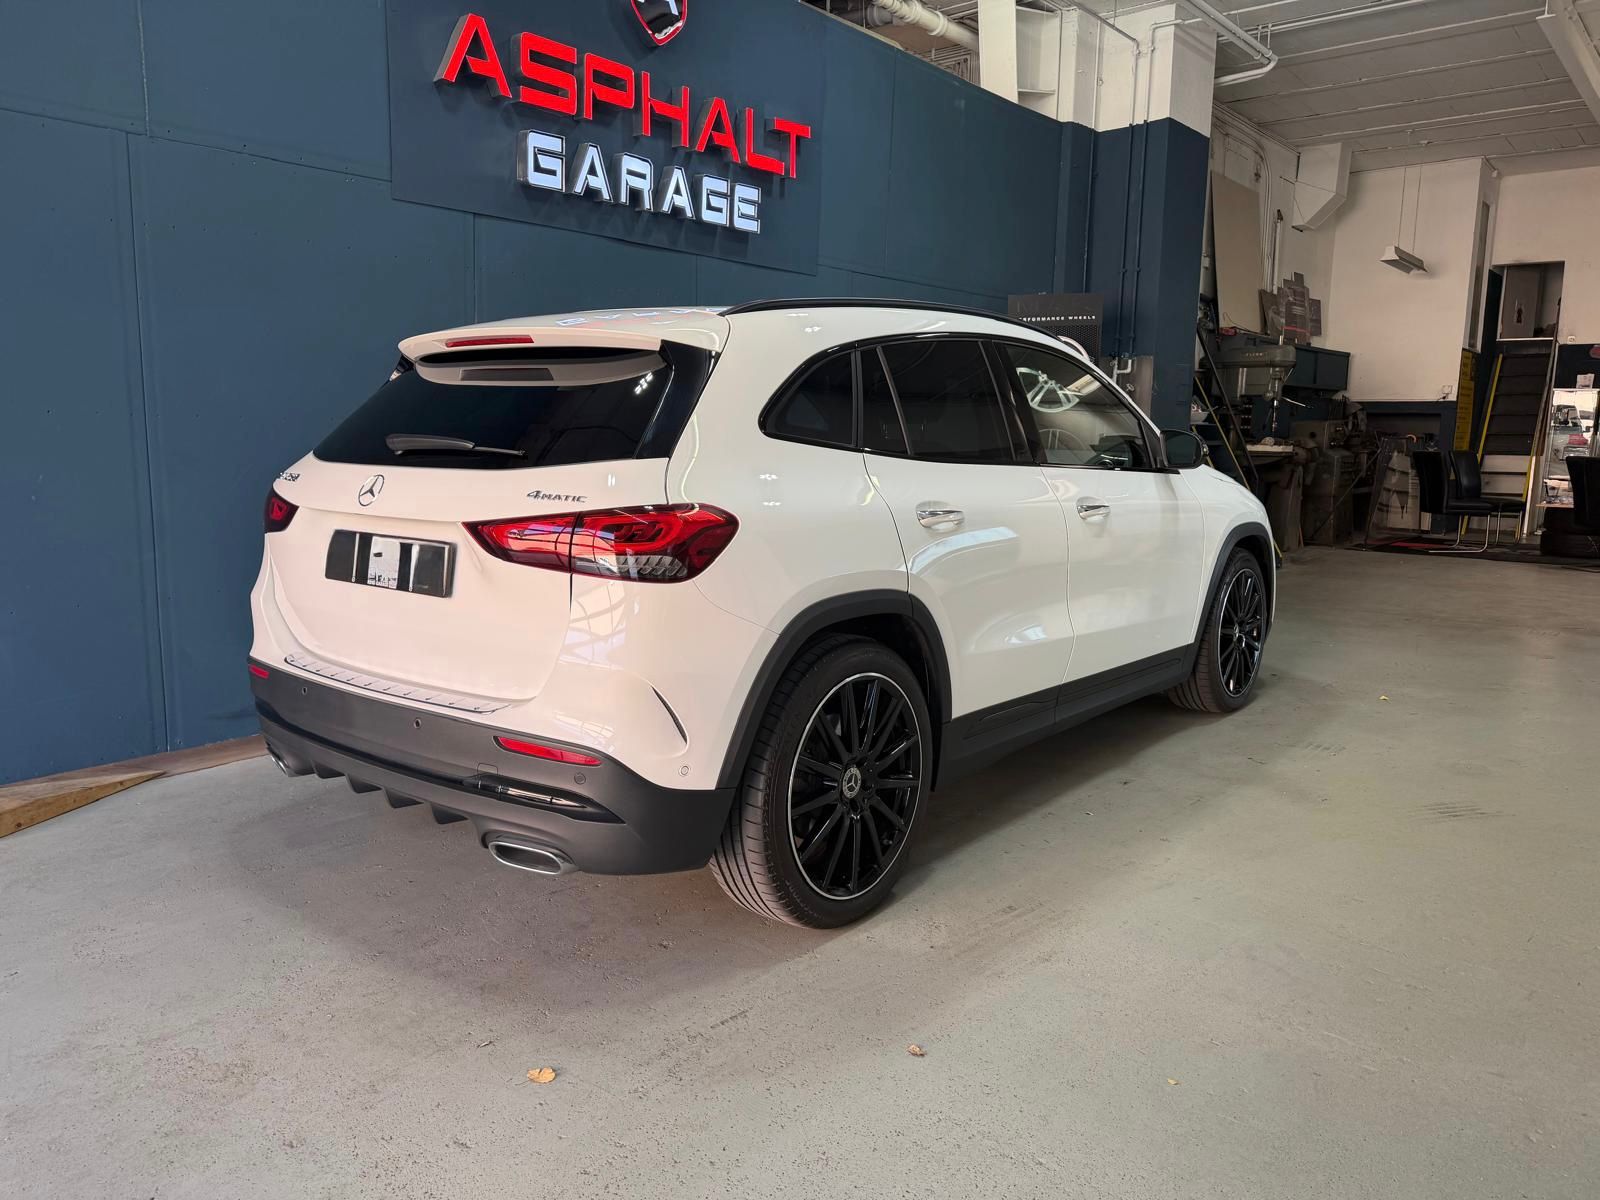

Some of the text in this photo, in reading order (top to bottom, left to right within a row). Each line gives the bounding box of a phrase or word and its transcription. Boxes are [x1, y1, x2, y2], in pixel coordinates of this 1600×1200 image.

[435, 13, 812, 179] ASPHALT
[517, 128, 762, 234] GARAGE
[526, 490, 588, 503] 4MATIC
